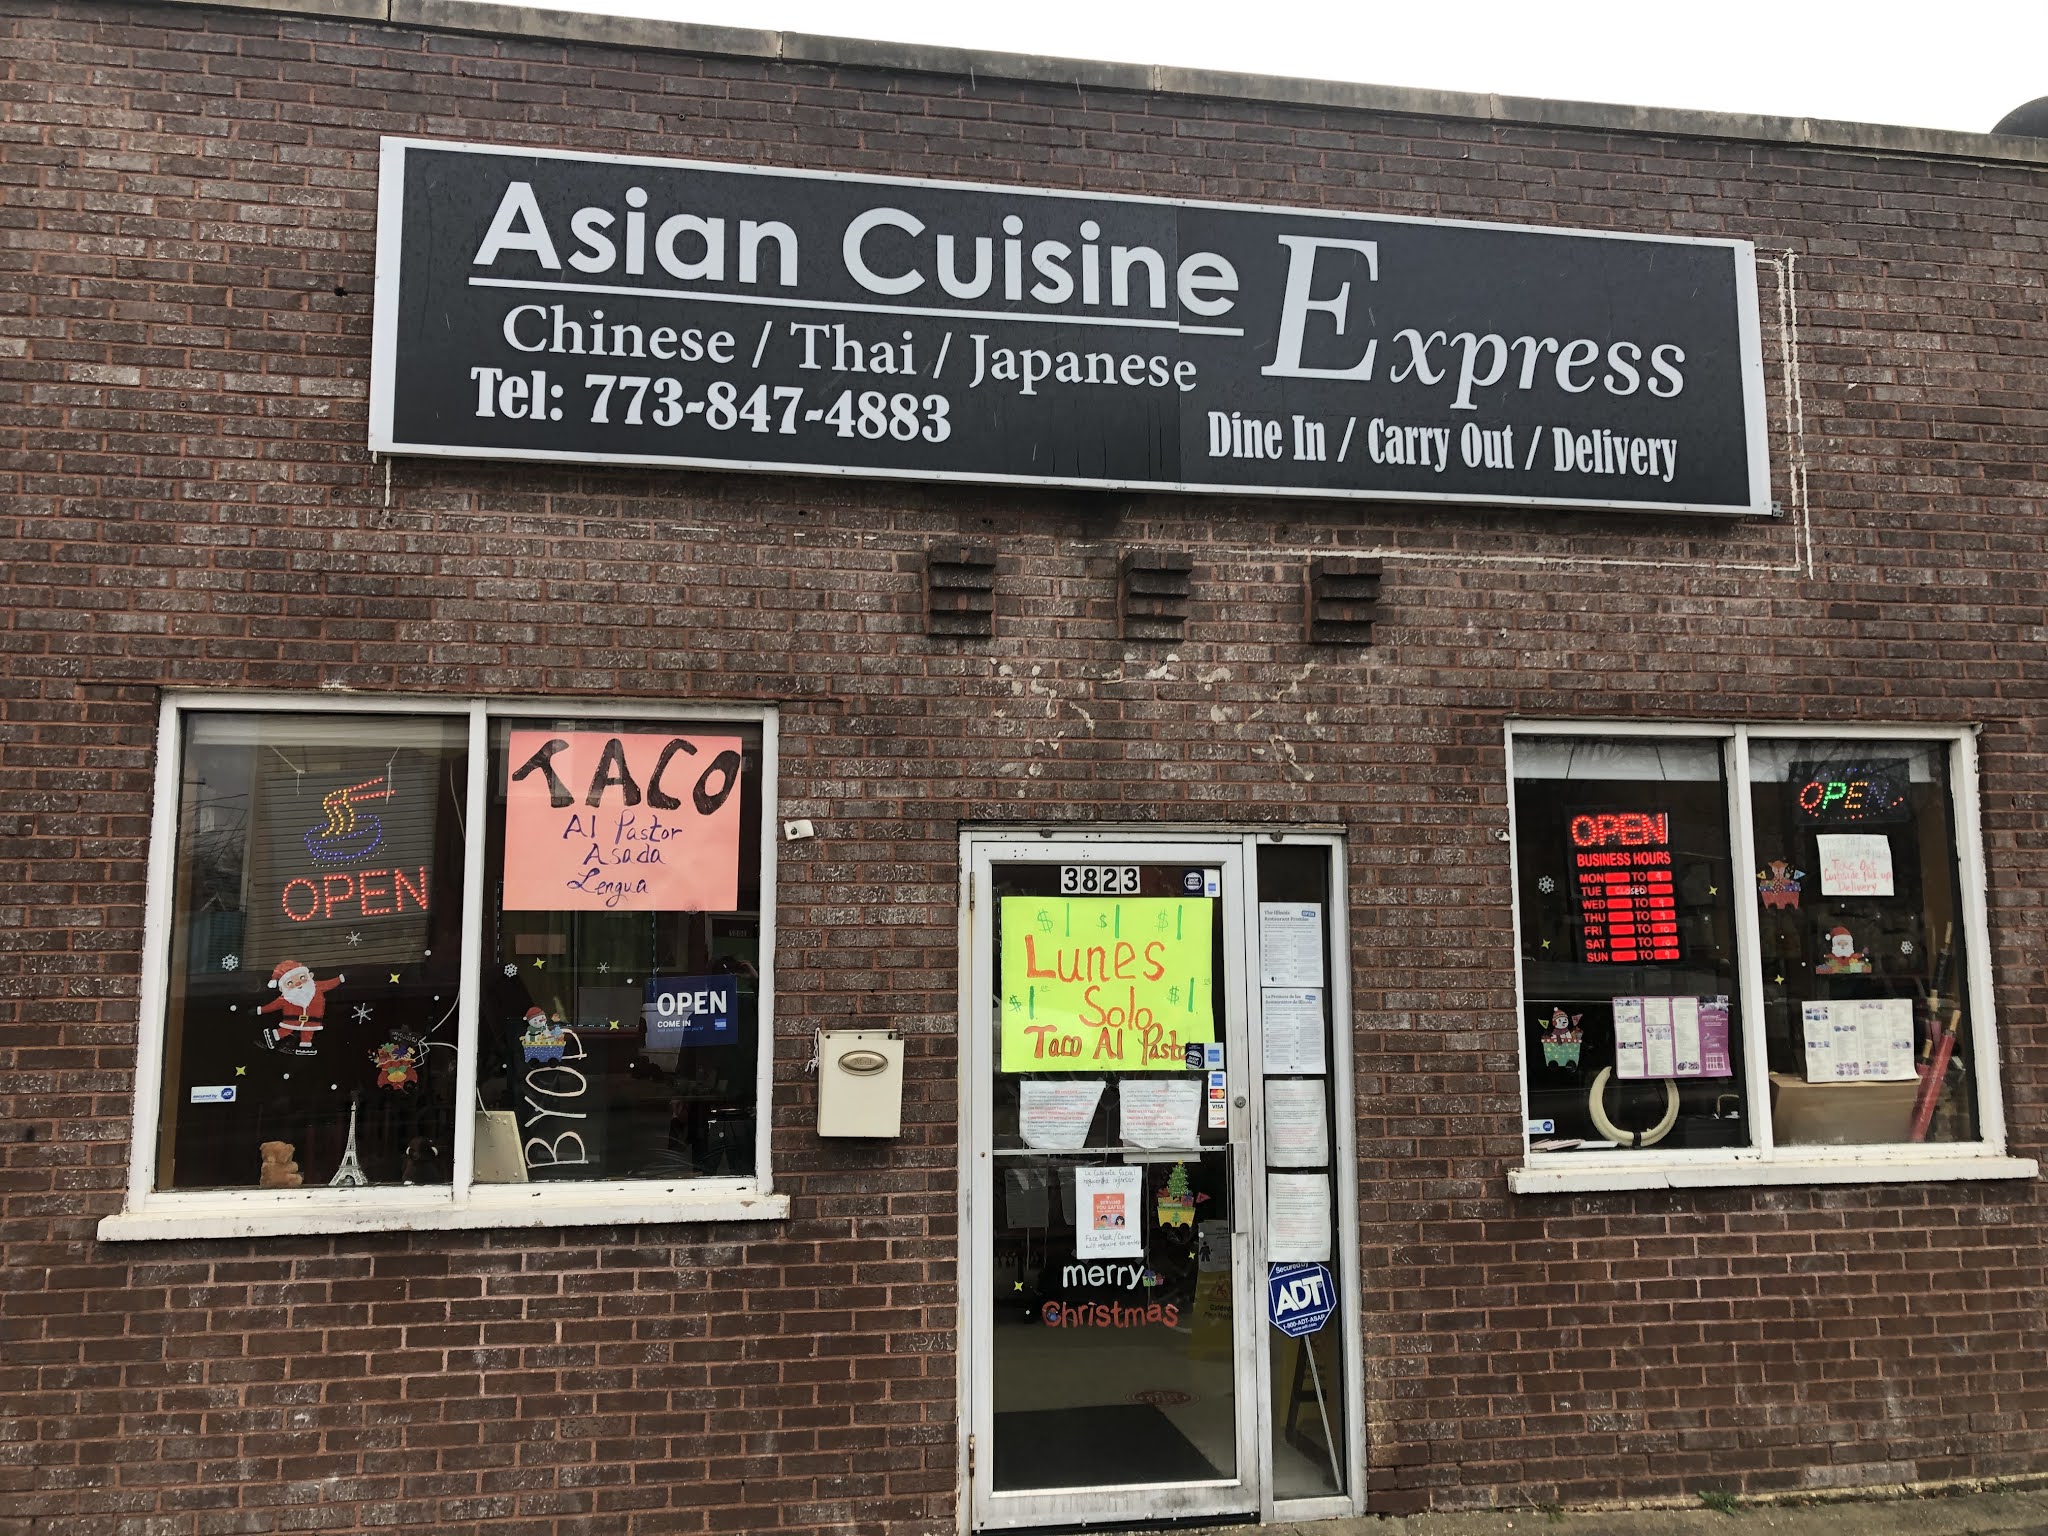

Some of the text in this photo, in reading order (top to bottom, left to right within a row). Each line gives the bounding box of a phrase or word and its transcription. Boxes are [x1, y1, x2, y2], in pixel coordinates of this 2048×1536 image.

[472, 180, 1686, 410] Asian Cuisine Express
[502, 304, 1198, 394] Chinese / Thai / Japanese
[470, 366, 952, 444] Tel: 773-847-4883
[1208, 411, 1678, 482] Dine In / Carry Out / Delivery
[512, 738, 740, 815] TACO
[1800, 781, 1890, 810] OPEN
[562, 809, 682, 845] Al Pastor
[1571, 813, 1666, 847] OPEN
[582, 843, 666, 866] Asada
[1577, 851, 1671, 867] BUSINESS HOURS
[566, 868, 648, 908] Lengua
[1063, 867, 1138, 892] 3823
[1579, 873, 1604, 884] MON
[1631, 871, 1647, 882] TO
[1581, 886, 1602, 897] TUE
[1837, 880, 1877, 895] Delivery
[282, 866, 428, 922] OPEN
[1582, 899, 1606, 909] WED
[1634, 898, 1649, 908] TO
[1583, 912, 1606, 923] THU
[1635, 910, 1650, 921] TO
[1584, 926, 1602, 936] FRI
[1636, 923, 1651, 934] TO
[1585, 938, 1606, 949] SAT
[1637, 937, 1652, 947] TO
[1586, 951, 1609, 962] SUN
[1638, 950, 1654, 960] TO
[1024, 934, 1165, 983] Lunes
[657, 990, 727, 1017] OPEN
[1078, 985, 1153, 1030] Solo
[657, 1020, 681, 1028] COME
[1024, 1022, 1187, 1066] Taco Al Pasto
[1062, 1263, 1144, 1290] merry
[1276, 1275, 1323, 1317] ADT
[1042, 1300, 1179, 1329] Christmas
[1283, 1313, 1326, 1330] 1-800-ADT-ASAP
